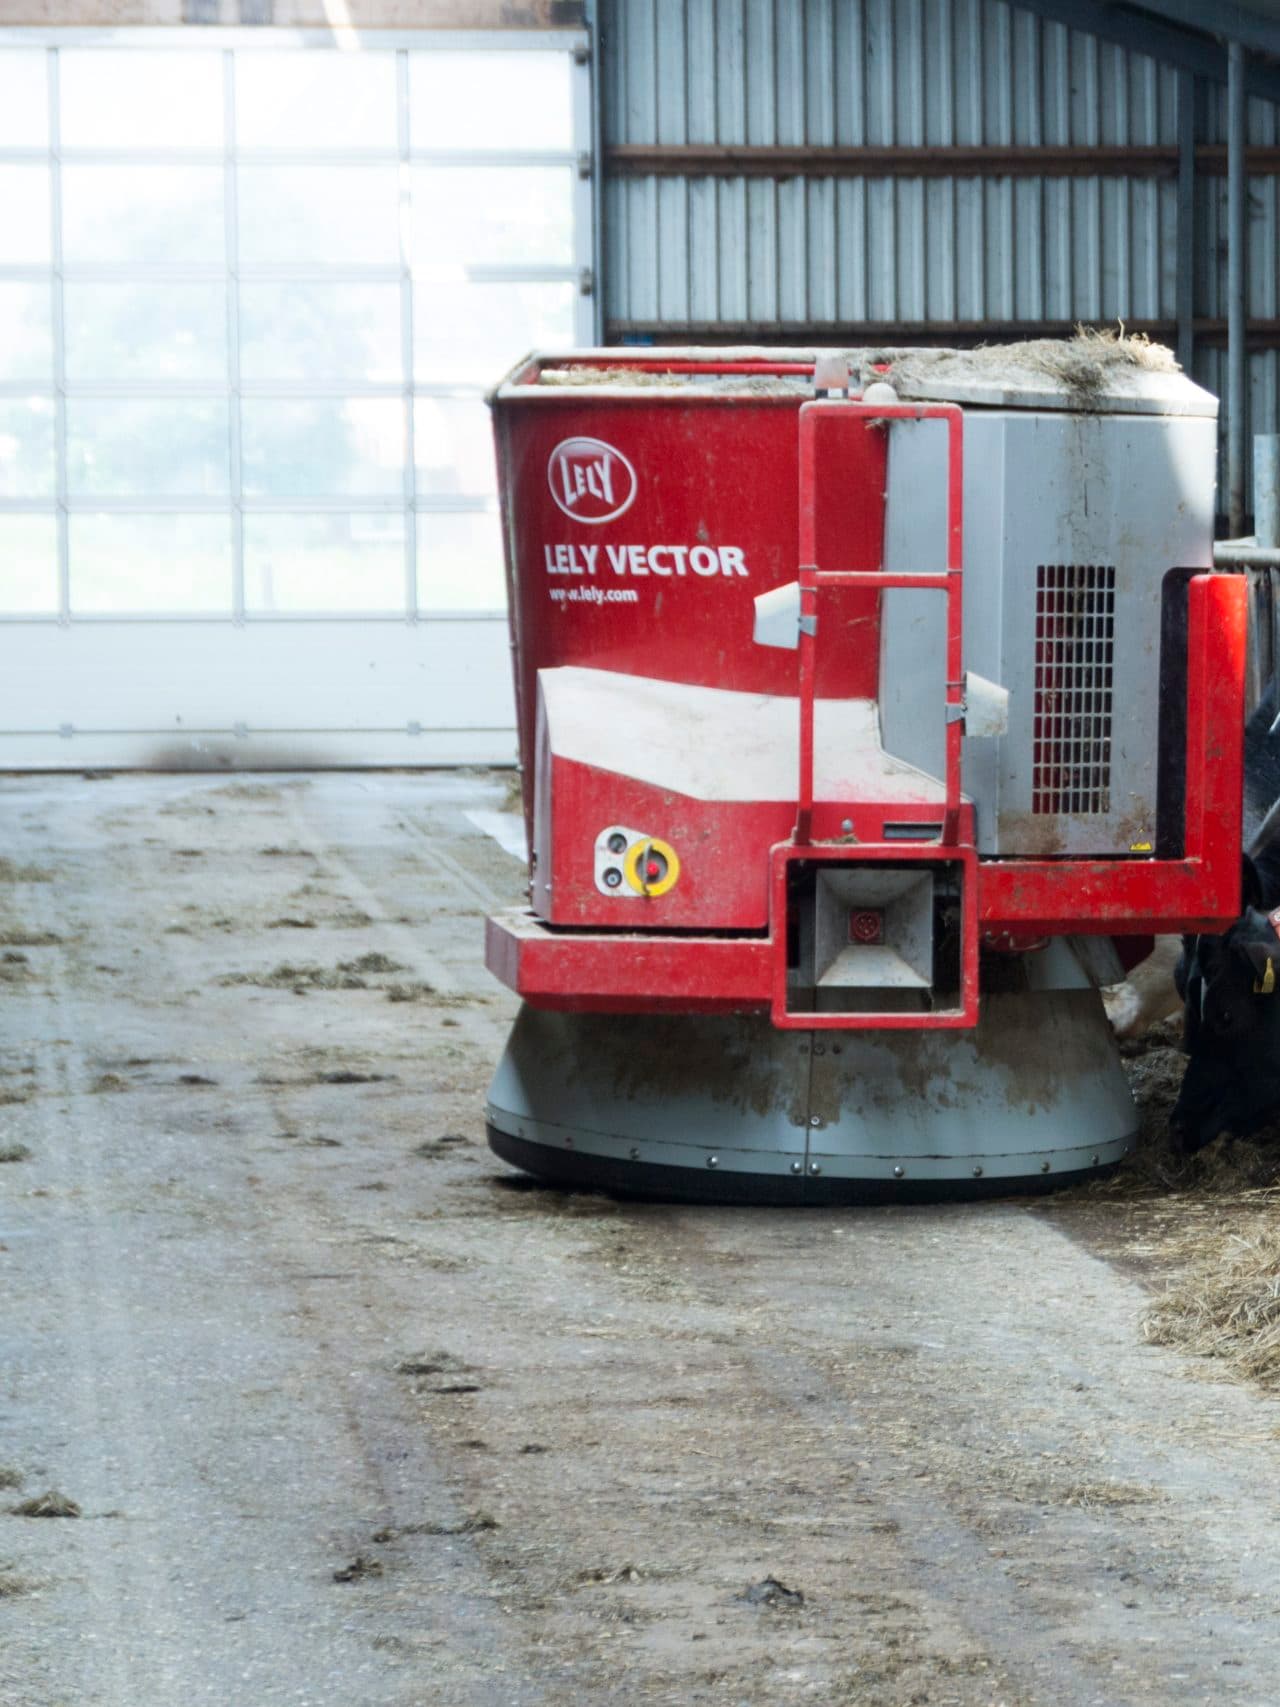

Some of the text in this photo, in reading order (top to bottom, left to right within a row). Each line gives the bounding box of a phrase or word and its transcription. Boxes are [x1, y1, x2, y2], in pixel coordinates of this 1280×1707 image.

[560, 453, 614, 506] LELY
[545, 544, 749, 576] LELY VECTOR
